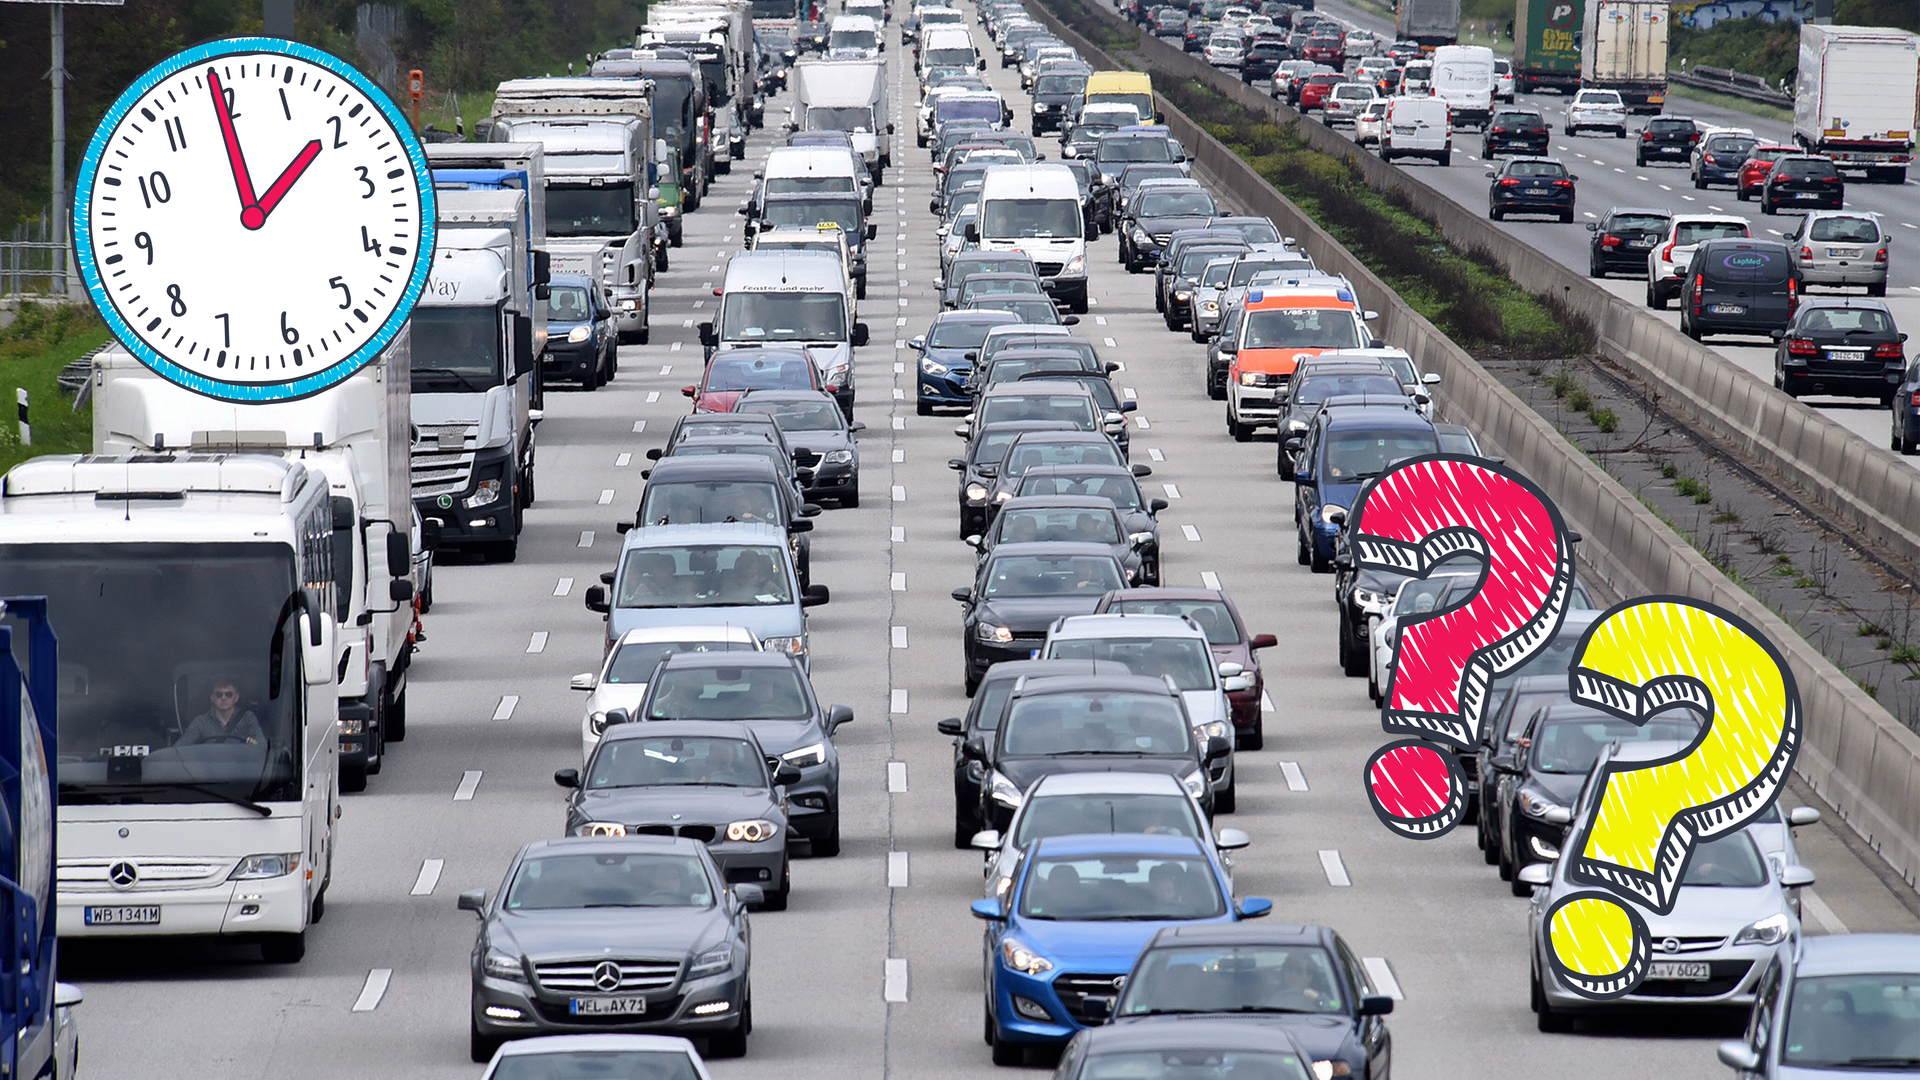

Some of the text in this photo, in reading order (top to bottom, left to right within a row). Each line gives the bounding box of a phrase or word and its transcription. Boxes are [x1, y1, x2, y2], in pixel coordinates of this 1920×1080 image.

[1733, 257, 1761, 266] LapMed
[94, 908, 158, 922] WB 1341M
[1677, 963, 1708, 977] 6021
[577, 1001, 602, 1012] WEL
